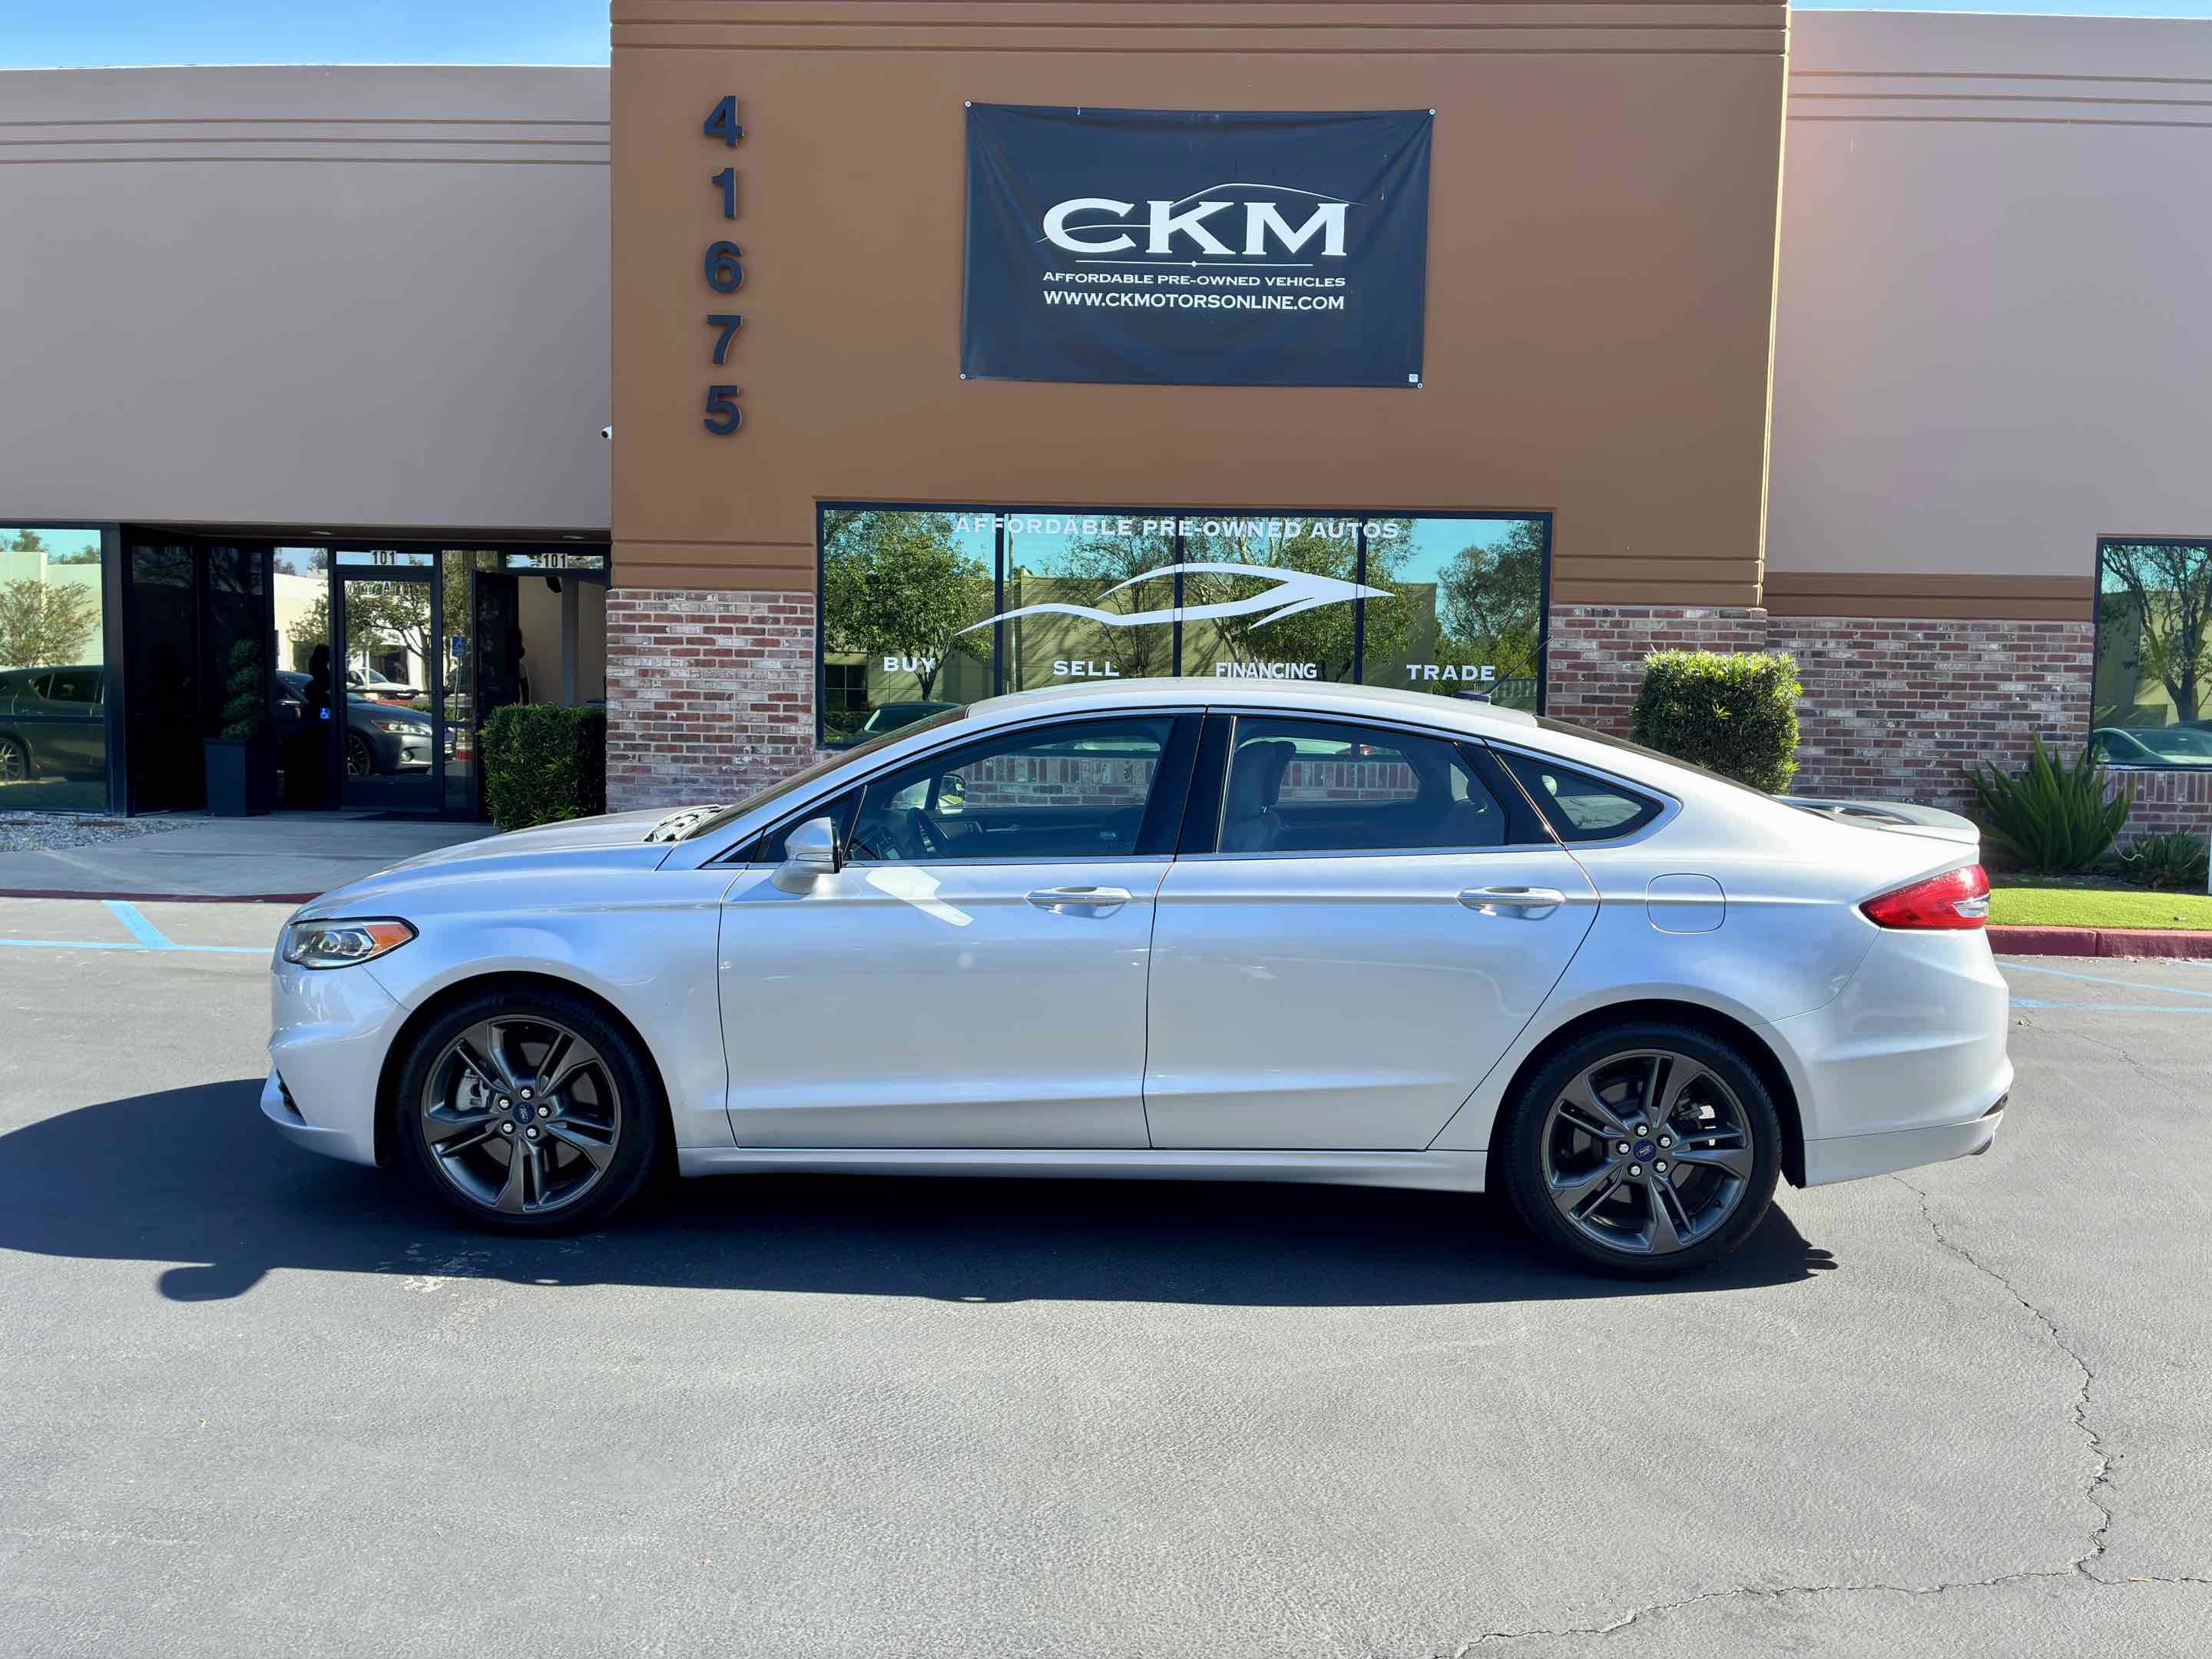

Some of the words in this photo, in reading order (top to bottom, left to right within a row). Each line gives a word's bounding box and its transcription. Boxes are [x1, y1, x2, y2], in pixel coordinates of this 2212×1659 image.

[1042, 197, 1349, 257] CKM
[704, 94, 744, 435] 41675
[1043, 271, 1154, 283] AFFORDABLE
[1157, 275, 1260, 286] PRE-OWNED
[1264, 277, 1346, 287] VEHICLES
[1043, 290, 1345, 310] WWW.CKMOTORSONLINE.COM
[955, 517, 1132, 536] AFFORDABLE
[1142, 520, 1301, 538] PRE-OWNED
[1310, 522, 1400, 539] AUTOS
[372, 551, 396, 565] 101
[543, 554, 566, 568] 101
[883, 657, 935, 673] BUY
[1052, 661, 1120, 677] SELL
[1216, 662, 1317, 679] FINANCING
[1406, 664, 1495, 681] TRADE
